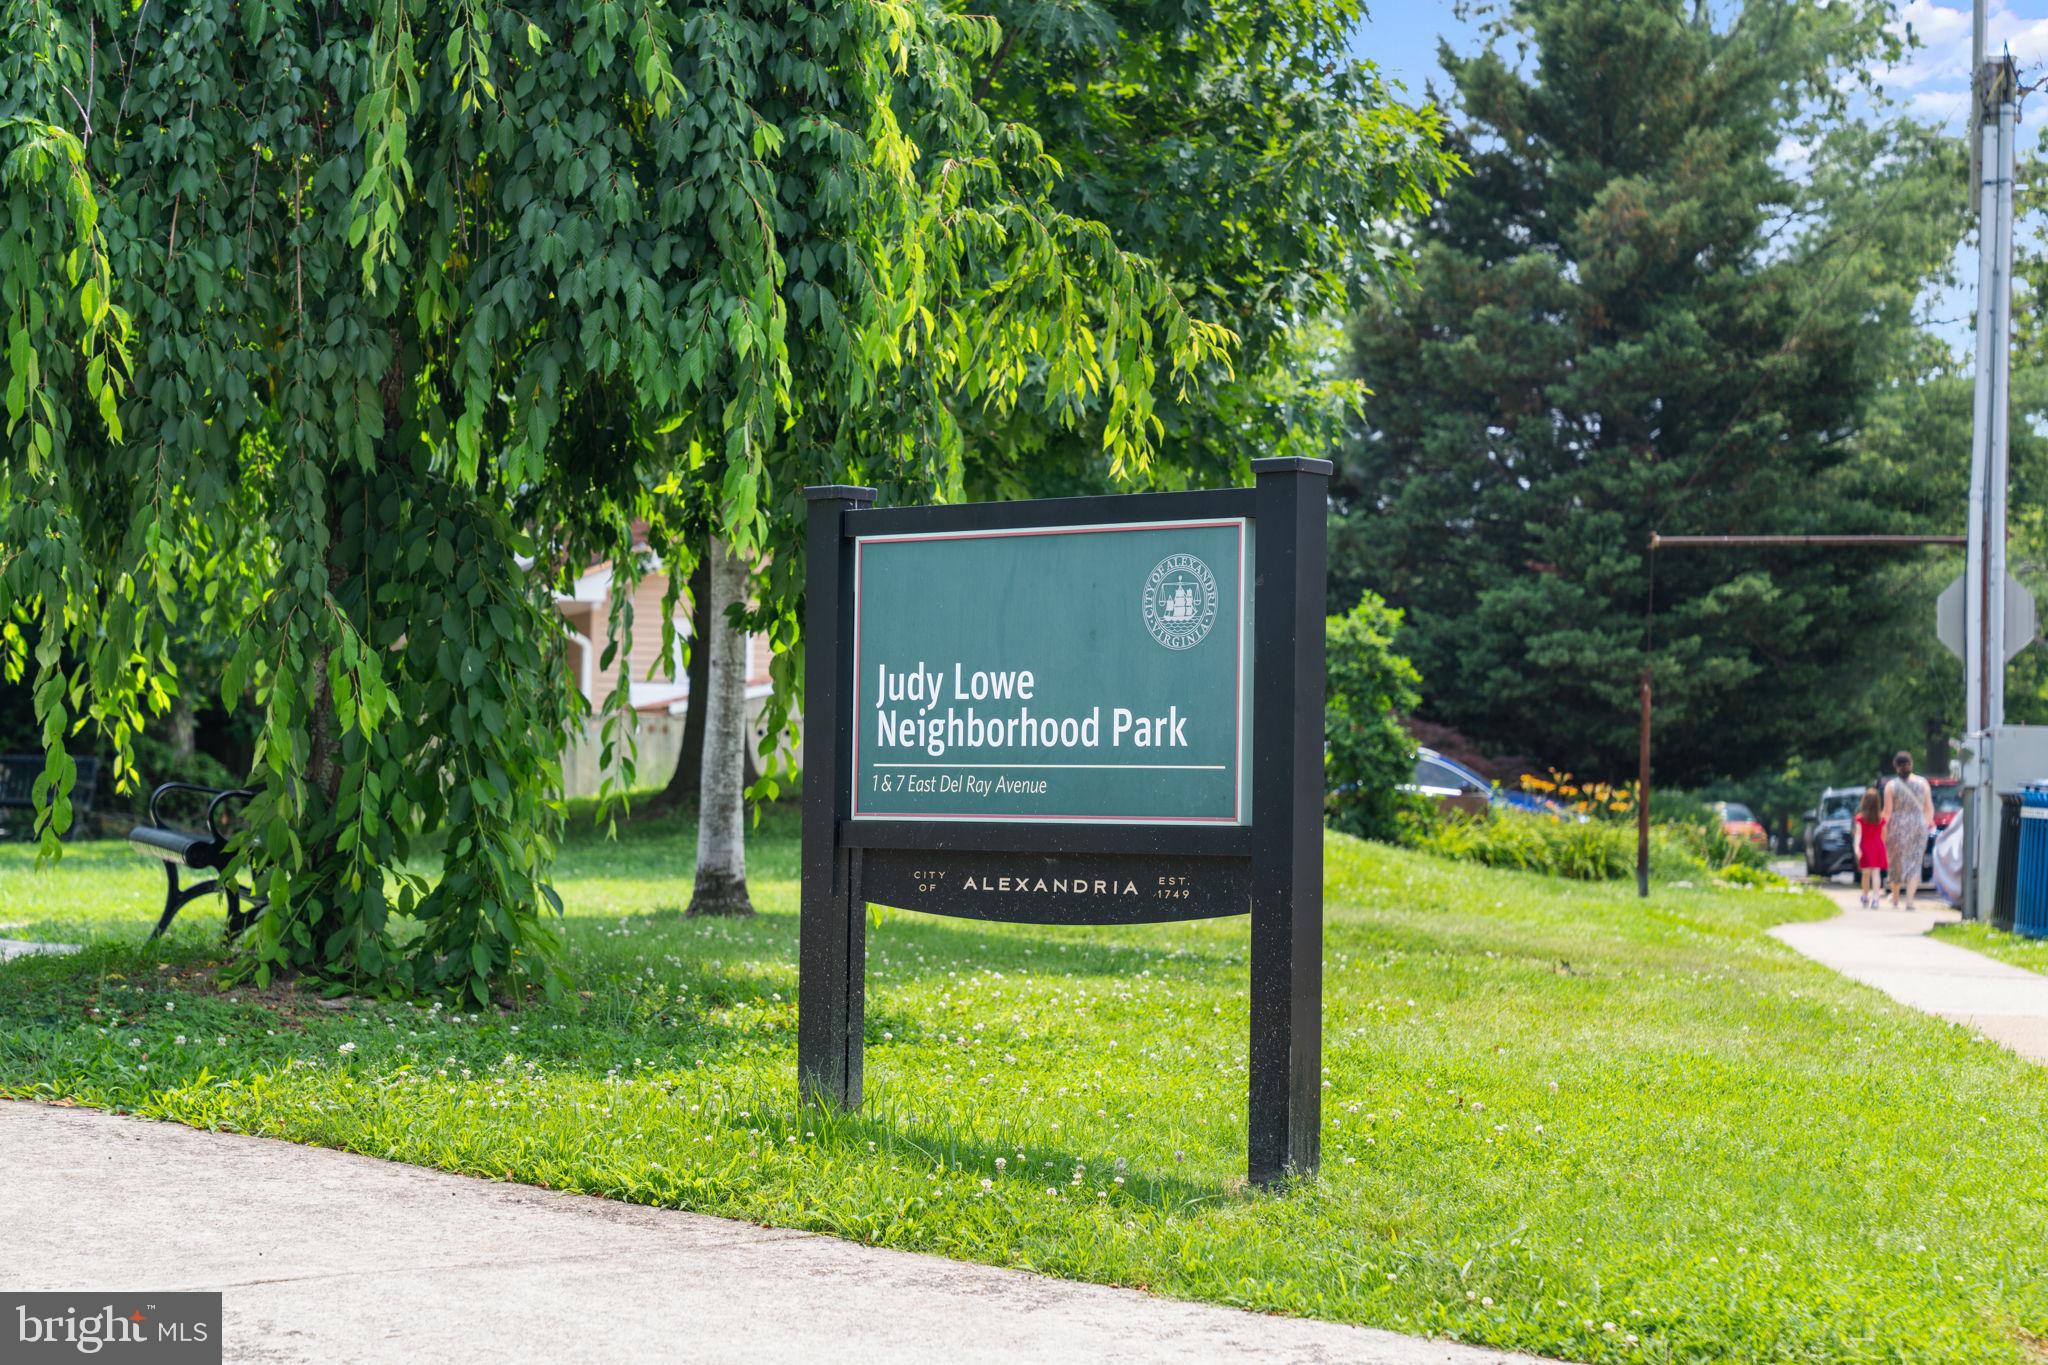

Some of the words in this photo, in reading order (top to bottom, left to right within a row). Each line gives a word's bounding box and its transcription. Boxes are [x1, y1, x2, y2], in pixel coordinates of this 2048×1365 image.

[1145, 585, 1155, 618] CITY
[1152, 568, 1165, 583] OF
[1167, 557, 1215, 616] ALEXANDRIA
[1152, 621, 1208, 647] VIRGINIA
[876, 661, 944, 710] Judy
[954, 662, 1035, 700] Lowe
[877, 706, 1100, 756] Neighborhood
[1112, 706, 1188, 747] Park
[872, 774, 878, 792] 1
[881, 774, 892, 792] &
[896, 775, 905, 792] 7
[908, 774, 937, 793] East
[940, 774, 963, 793] Del
[966, 775, 992, 798] Ray
[995, 775, 1047, 794] Avenue
[913, 870, 946, 880] CITY
[963, 876, 1139, 896] ALEXANDRIA
[1158, 876, 1190, 886] EST.
[918, 883, 937, 892] OF
[1157, 889, 1190, 899] 1749
